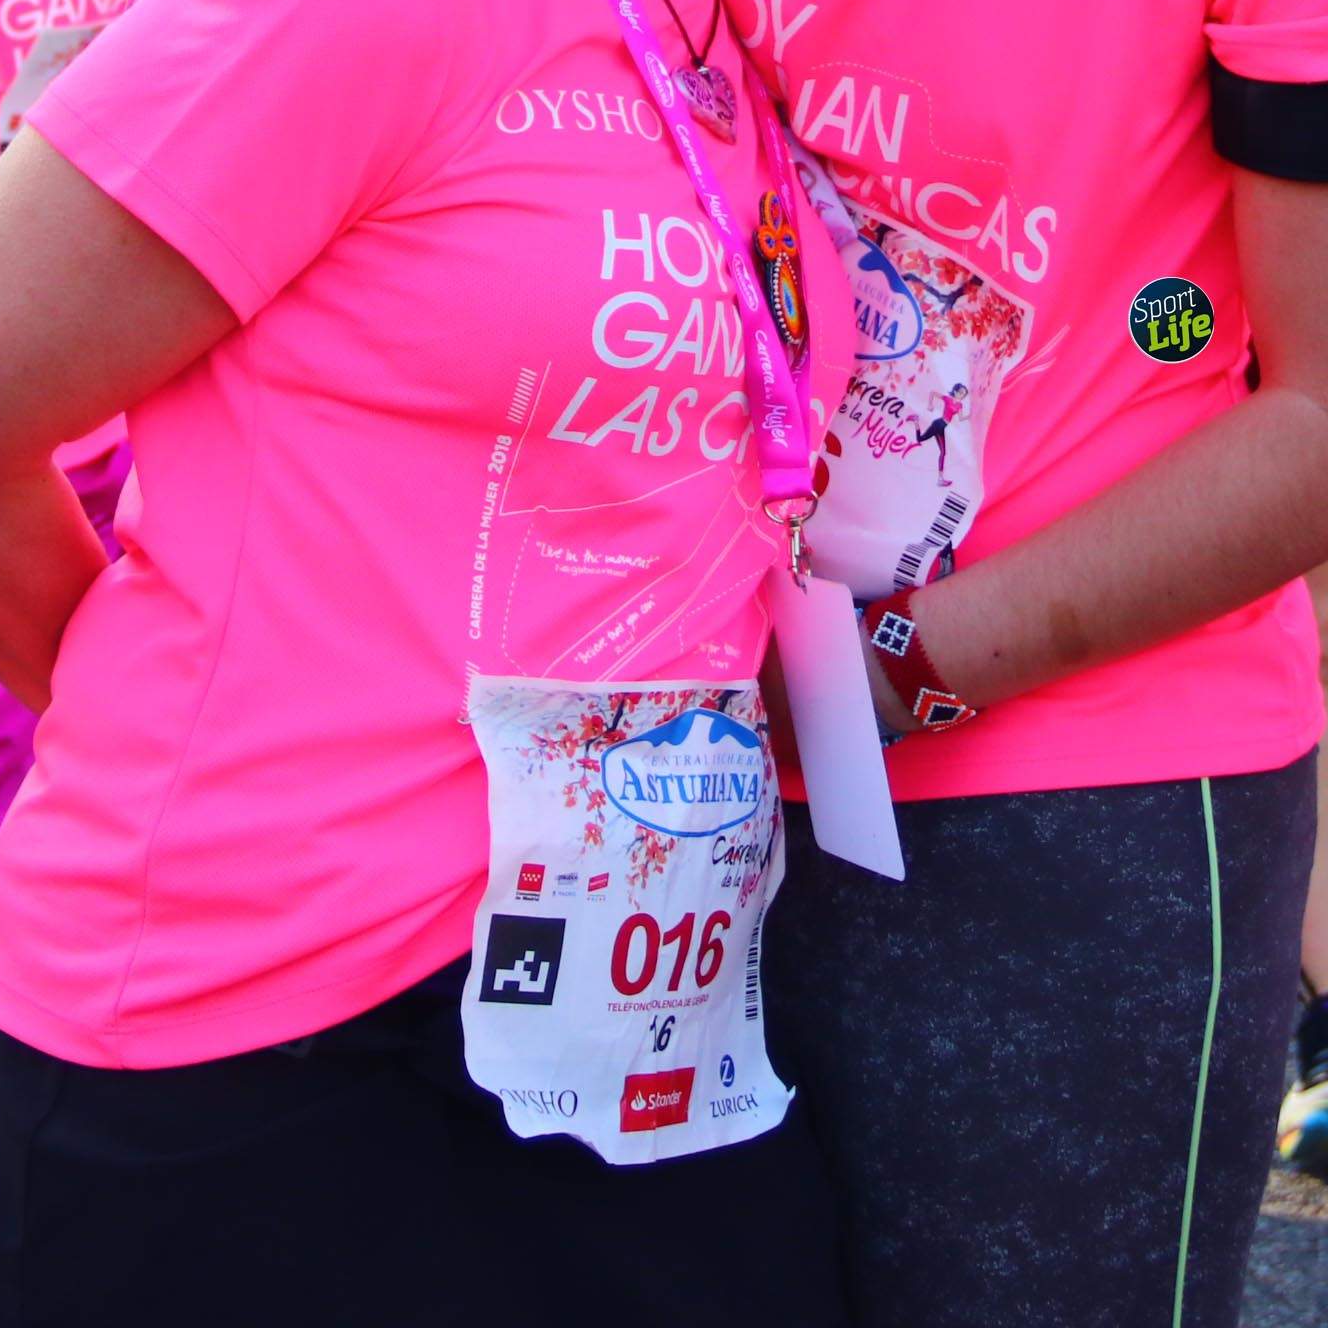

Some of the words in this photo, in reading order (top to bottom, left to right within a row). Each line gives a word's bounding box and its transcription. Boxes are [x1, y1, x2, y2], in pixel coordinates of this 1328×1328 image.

[496, 88, 664, 142] OYSHO
[1134, 286, 1197, 323] Sport
[1147, 309, 1211, 352] Life
[547, 376, 697, 455] LAS
[851, 408, 923, 460] Mujer
[488, 434, 514, 475] 2018
[480, 480, 501, 529] MUJER
[474, 552, 487, 573] DE
[477, 530, 490, 551] LA
[468, 574, 484, 640] CARRERA
[619, 758, 759, 804] ASTURIANA
[611, 910, 731, 996] 016
[710, 1092, 760, 1119] ZURICH
